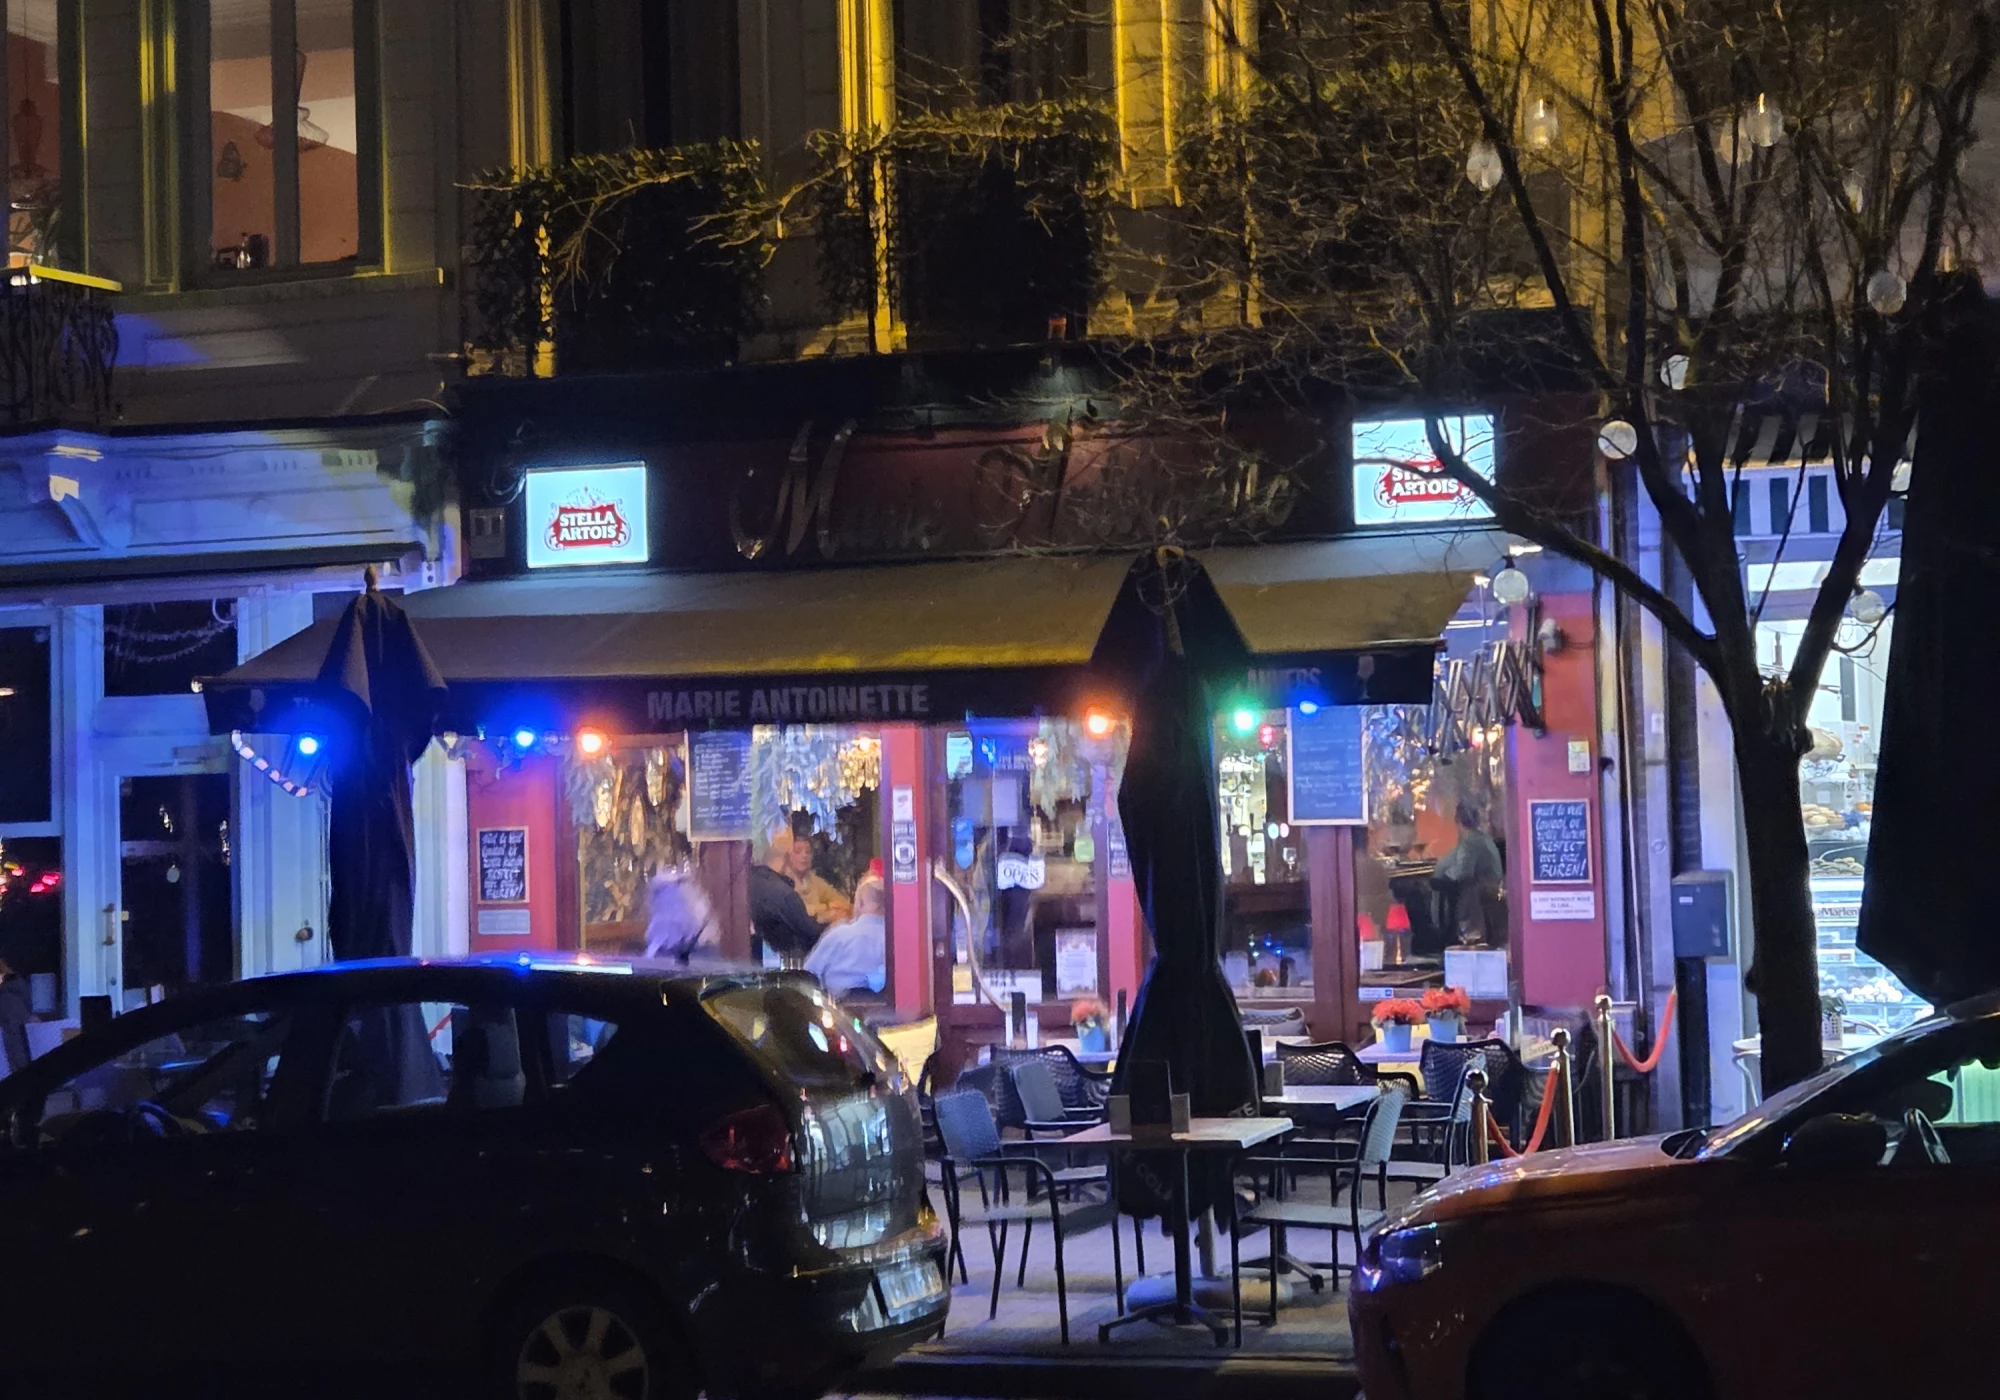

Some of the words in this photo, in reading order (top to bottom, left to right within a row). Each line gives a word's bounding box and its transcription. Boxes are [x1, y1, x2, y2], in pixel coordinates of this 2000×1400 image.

[1392, 479, 1459, 496] ARTOIS
[560, 511, 616, 527] STELLA
[559, 525, 617, 541] ARTOIS
[648, 690, 741, 719] MARIE
[750, 684, 930, 718] ANTOINETTE
[1003, 867, 1040, 884] OPEN
